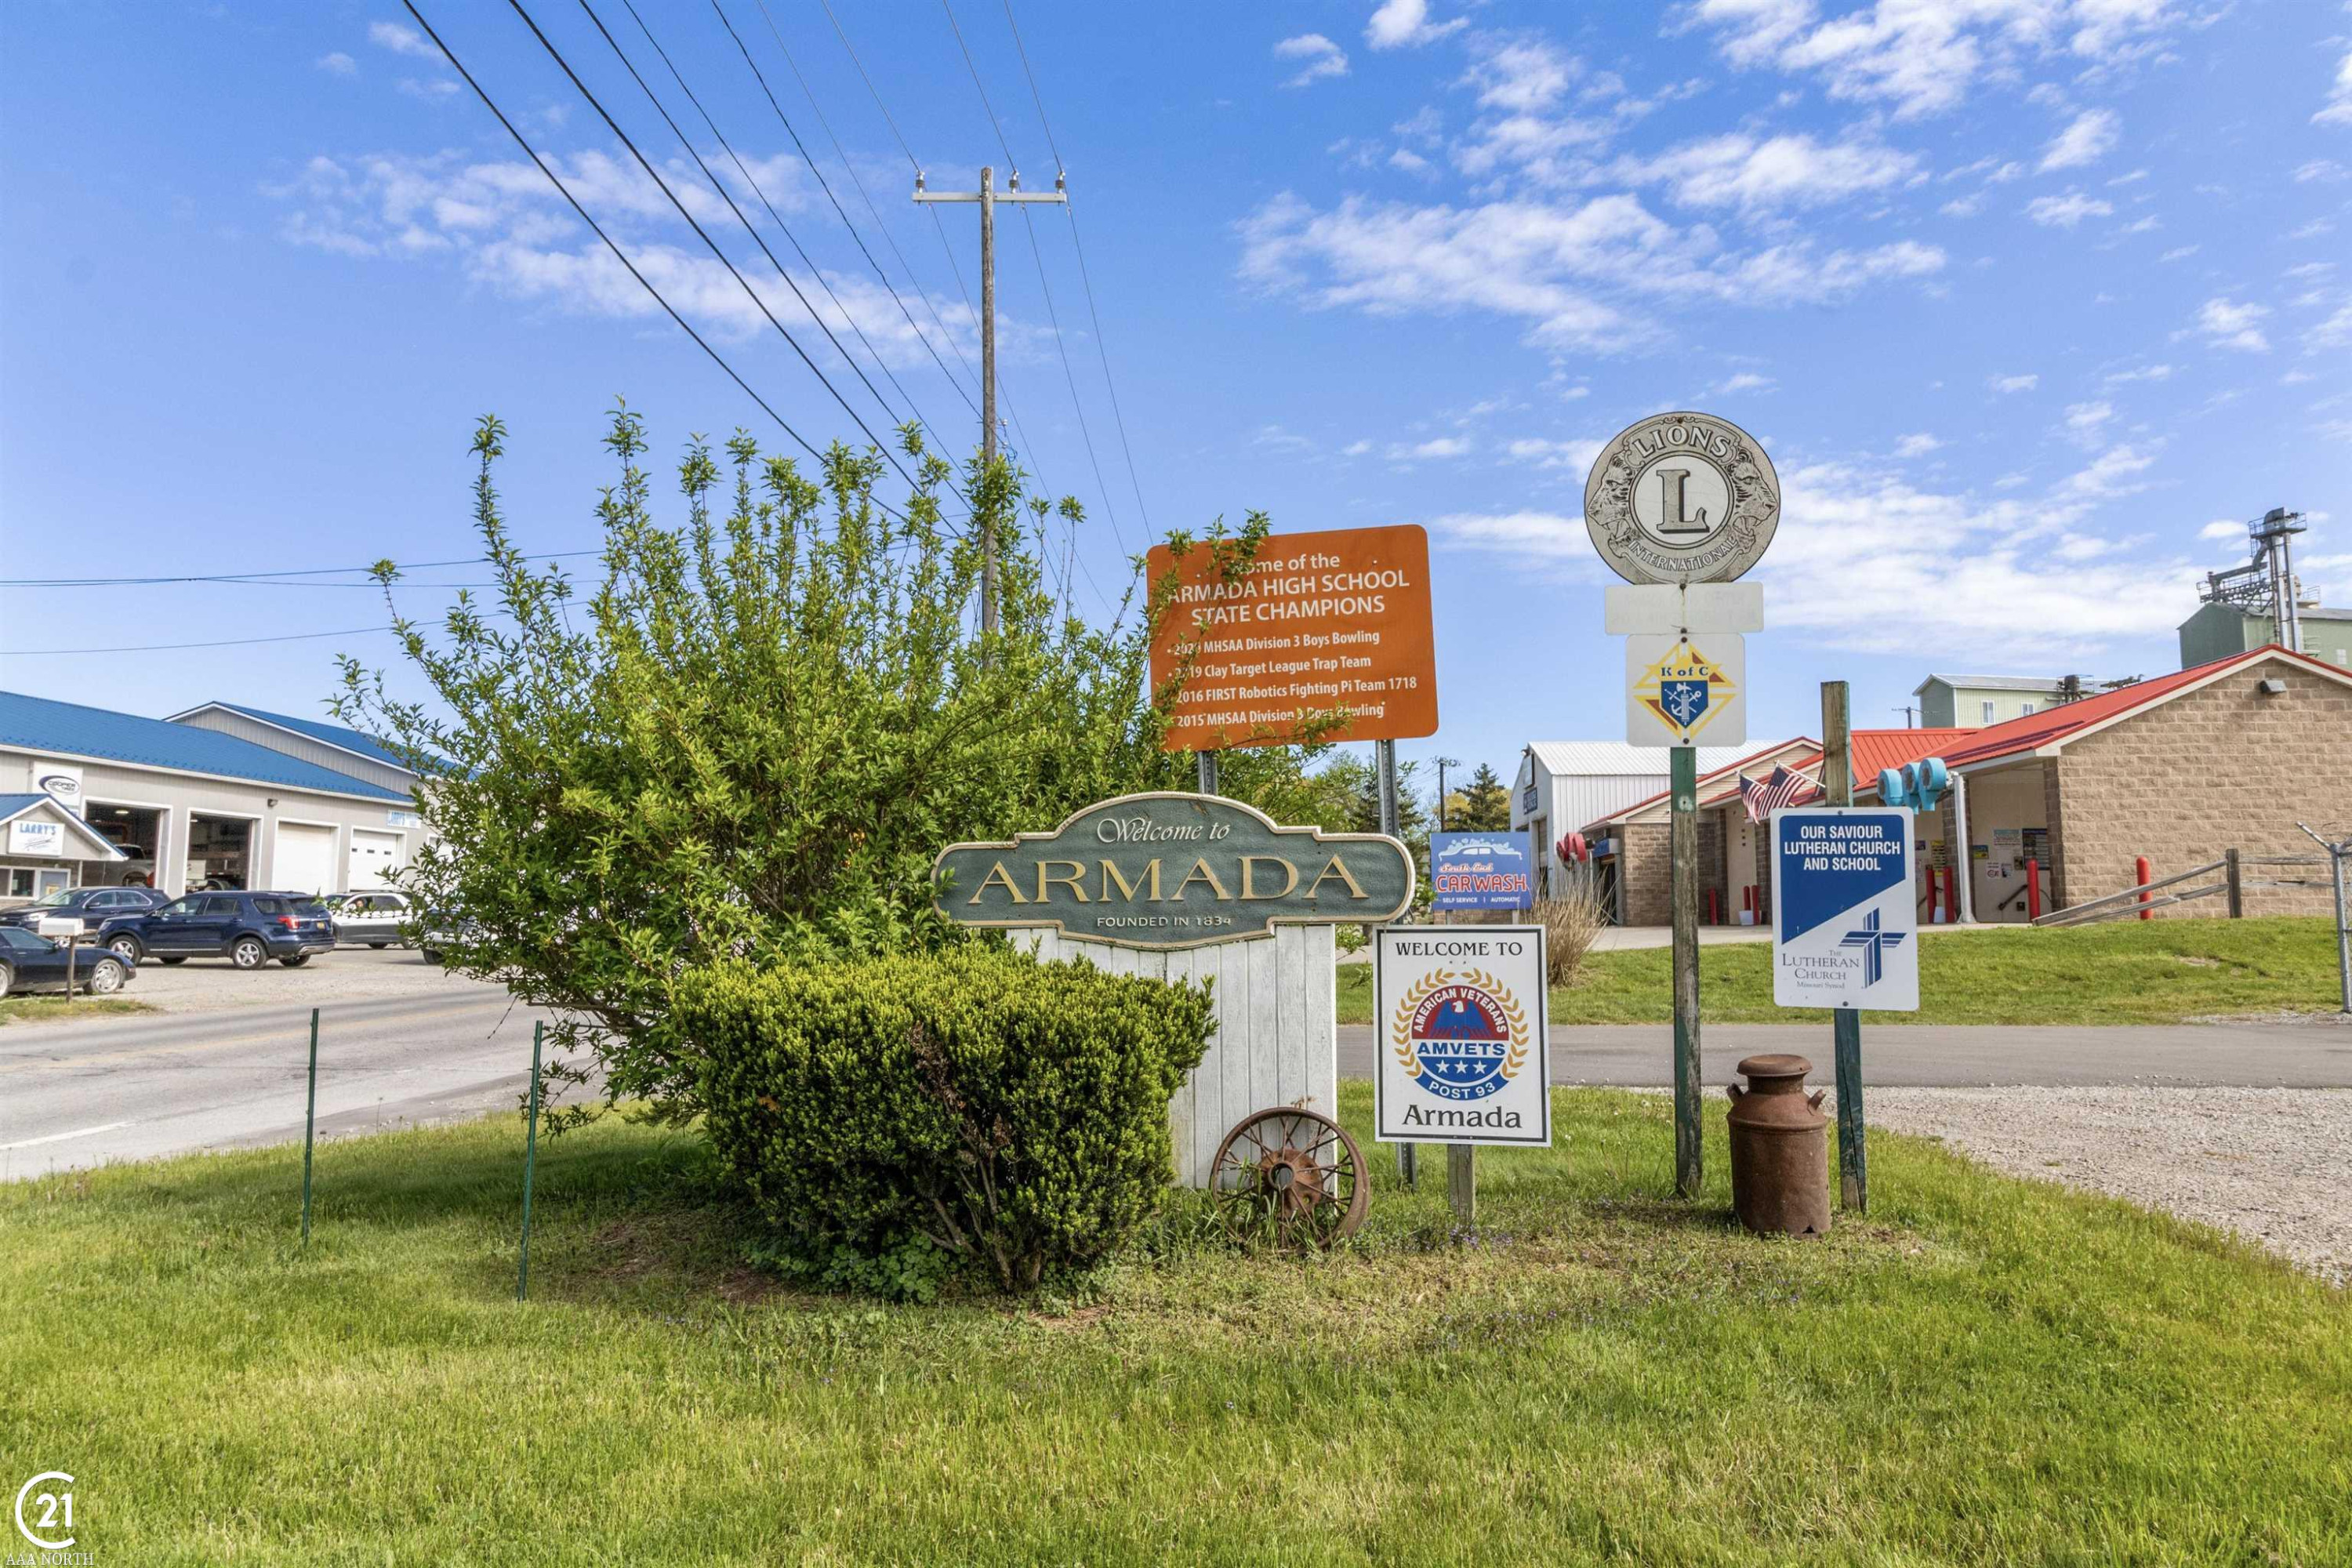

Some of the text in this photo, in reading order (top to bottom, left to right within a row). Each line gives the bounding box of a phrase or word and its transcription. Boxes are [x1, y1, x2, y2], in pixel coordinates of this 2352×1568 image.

[1632, 425, 1731, 458] LIONS
[1656, 469, 1710, 535] L
[1288, 554, 1307, 571] of
[1310, 553, 1340, 569] the
[1628, 536, 1740, 572] INTERNATIONAL
[1168, 569, 1410, 603] ARMADA HIGH SCHOOL
[1191, 595, 1385, 626] STATE CHAMPIONS
[1203, 639, 1243, 653] MHSAA
[1247, 637, 1290, 650] Division
[1294, 635, 1300, 648] 3
[1303, 634, 1330, 649] Boys
[1333, 630, 1380, 645] Bowling
[1204, 664, 1228, 679] Clay
[1230, 662, 1266, 677] Target
[1269, 661, 1310, 674] League
[1312, 658, 1338, 672] Trap
[1340, 655, 1371, 669] Team
[1661, 666, 1708, 677] K of C
[1176, 677, 1417, 703] 2016 FIRST Robotics Fighting Pi Team 1718
[1177, 713, 1204, 728] 2015
[1207, 711, 1247, 725] MHSAA
[1250, 709, 1294, 723] Division
[19, 822, 57, 836] LARRY'S
[1097, 816, 1230, 844] Welcome to
[1800, 826, 1883, 839] OUR SAVIOUR
[1784, 841, 1900, 855] LUTHERAN CHURCH
[1439, 862, 1472, 873] South
[1803, 857, 1882, 871] AND SCHOOL
[967, 855, 1370, 904] ARMADA
[1097, 916, 1232, 927] FOUNDED IN 1834
[1396, 942, 1523, 956] WELCOME TO
[1782, 953, 1860, 968] LUTHERAN
[1795, 967, 1846, 980] CHURCH
[1413, 987, 1507, 1034] AMERICAN VETERANS
[1417, 1042, 1506, 1056] AMVETS
[1428, 1080, 1496, 1099] POST 93
[1402, 1104, 1523, 1129] Armada
